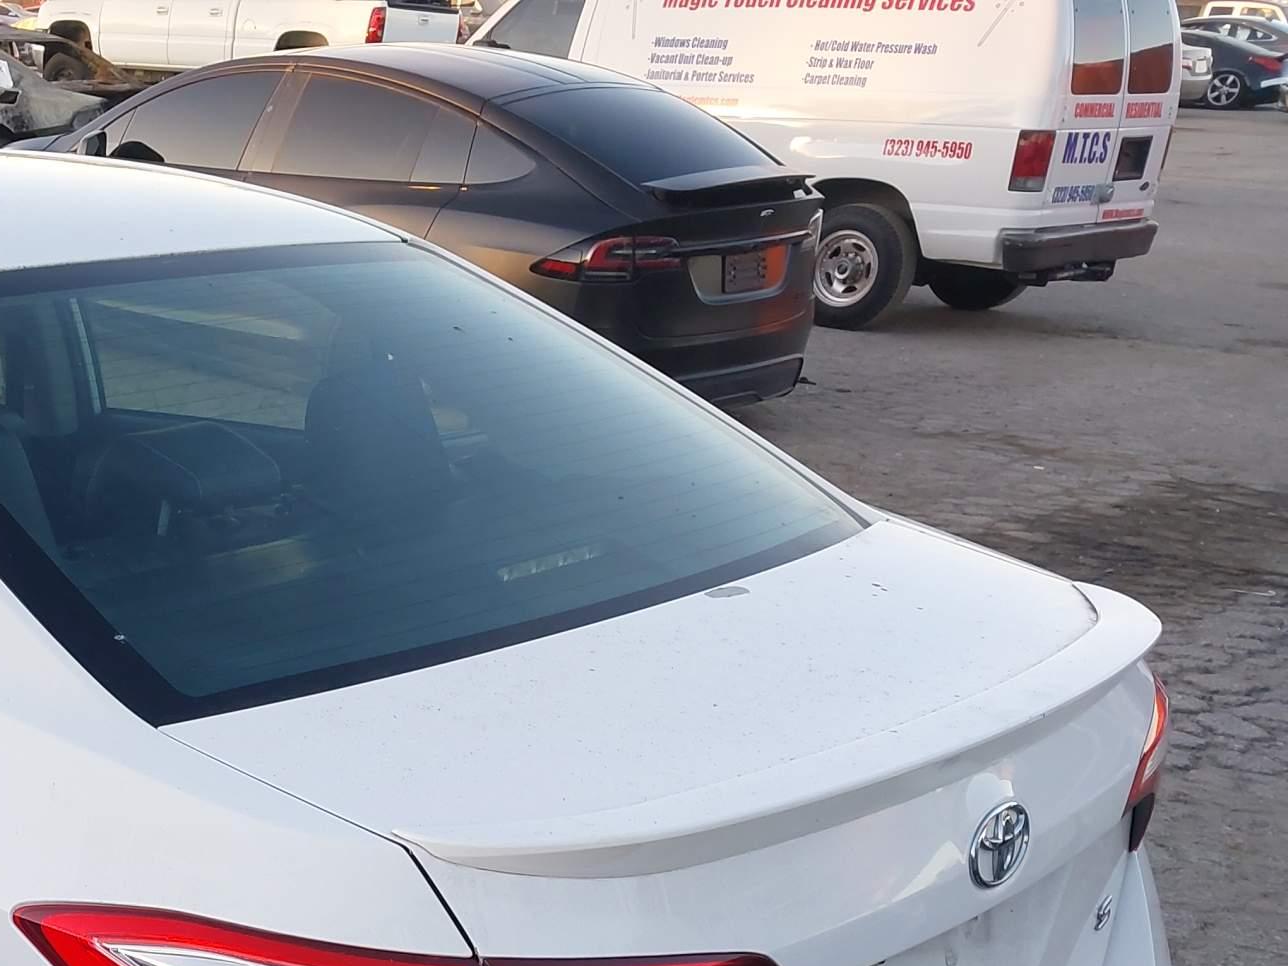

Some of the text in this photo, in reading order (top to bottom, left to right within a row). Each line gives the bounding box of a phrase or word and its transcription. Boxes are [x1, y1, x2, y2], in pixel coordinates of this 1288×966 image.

[691, 37, 729, 50] Cleaning
[850, 41, 875, 52] Water
[875, 42, 913, 54] Pressure
[913, 43, 938, 54] Wash
[678, 54, 695, 64] Unit
[695, 54, 733, 66] Clean-up
[835, 57, 853, 69] Wax
[853, 58, 874, 70] Floor
[691, 70, 717, 82] Porter
[718, 71, 755, 83] Services
[831, 74, 867, 88] Cleaning
[882, 138, 973, 160] (323) 945-5950
[1062, 131, 1111, 164] M.T.C.S
[1094, 894, 1113, 931] S
